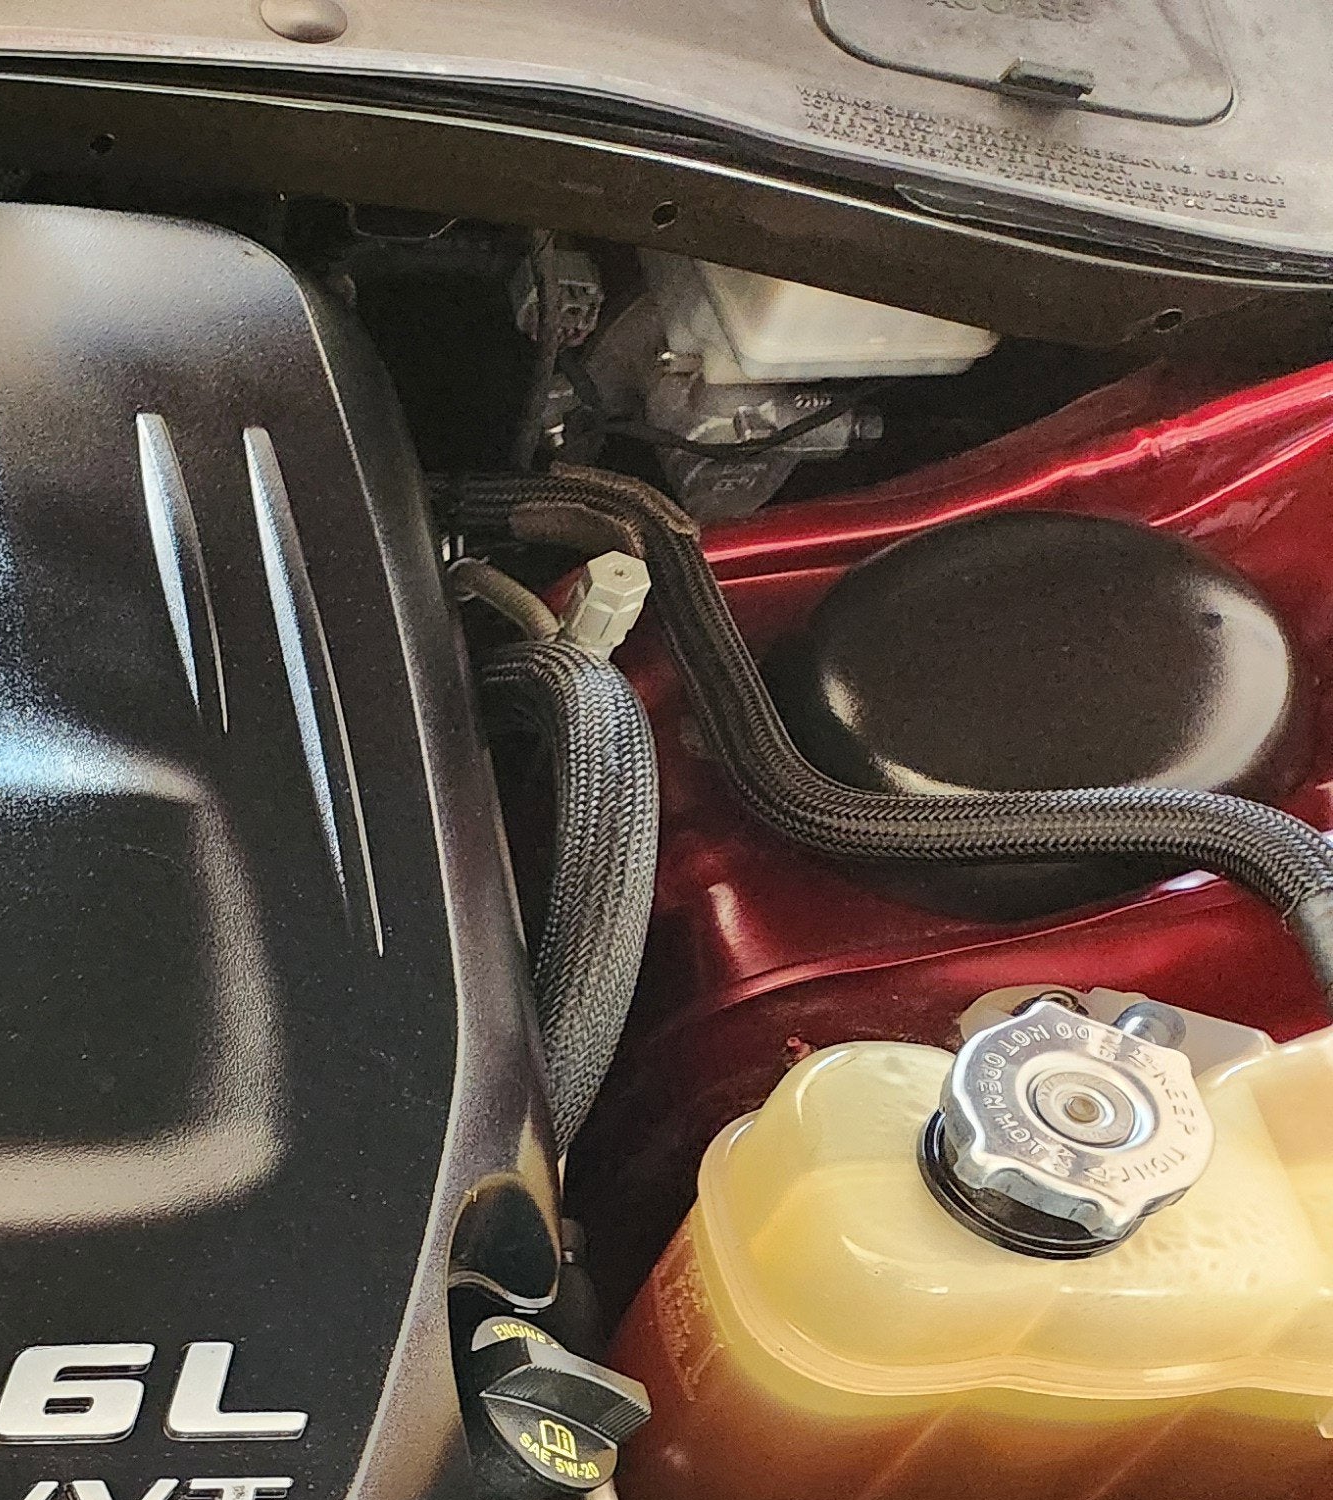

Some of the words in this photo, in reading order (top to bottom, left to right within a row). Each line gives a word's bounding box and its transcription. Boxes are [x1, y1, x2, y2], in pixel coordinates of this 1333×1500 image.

[1203, 167, 1240, 181] USE
[1242, 171, 1286, 186] ONLY
[1166, 183, 1288, 209] REMPLISSAGE
[997, 1023, 1052, 1057] NOT
[1056, 1020, 1091, 1040] DO
[977, 1051, 1008, 1111] OPEN
[1151, 1070, 1199, 1136] KEEP
[993, 1111, 1049, 1156] HOT
[491, 1323, 547, 1344] ENGINE
[518, 1431, 553, 1467] SAE
[553, 1459, 601, 1480] 5W-20
